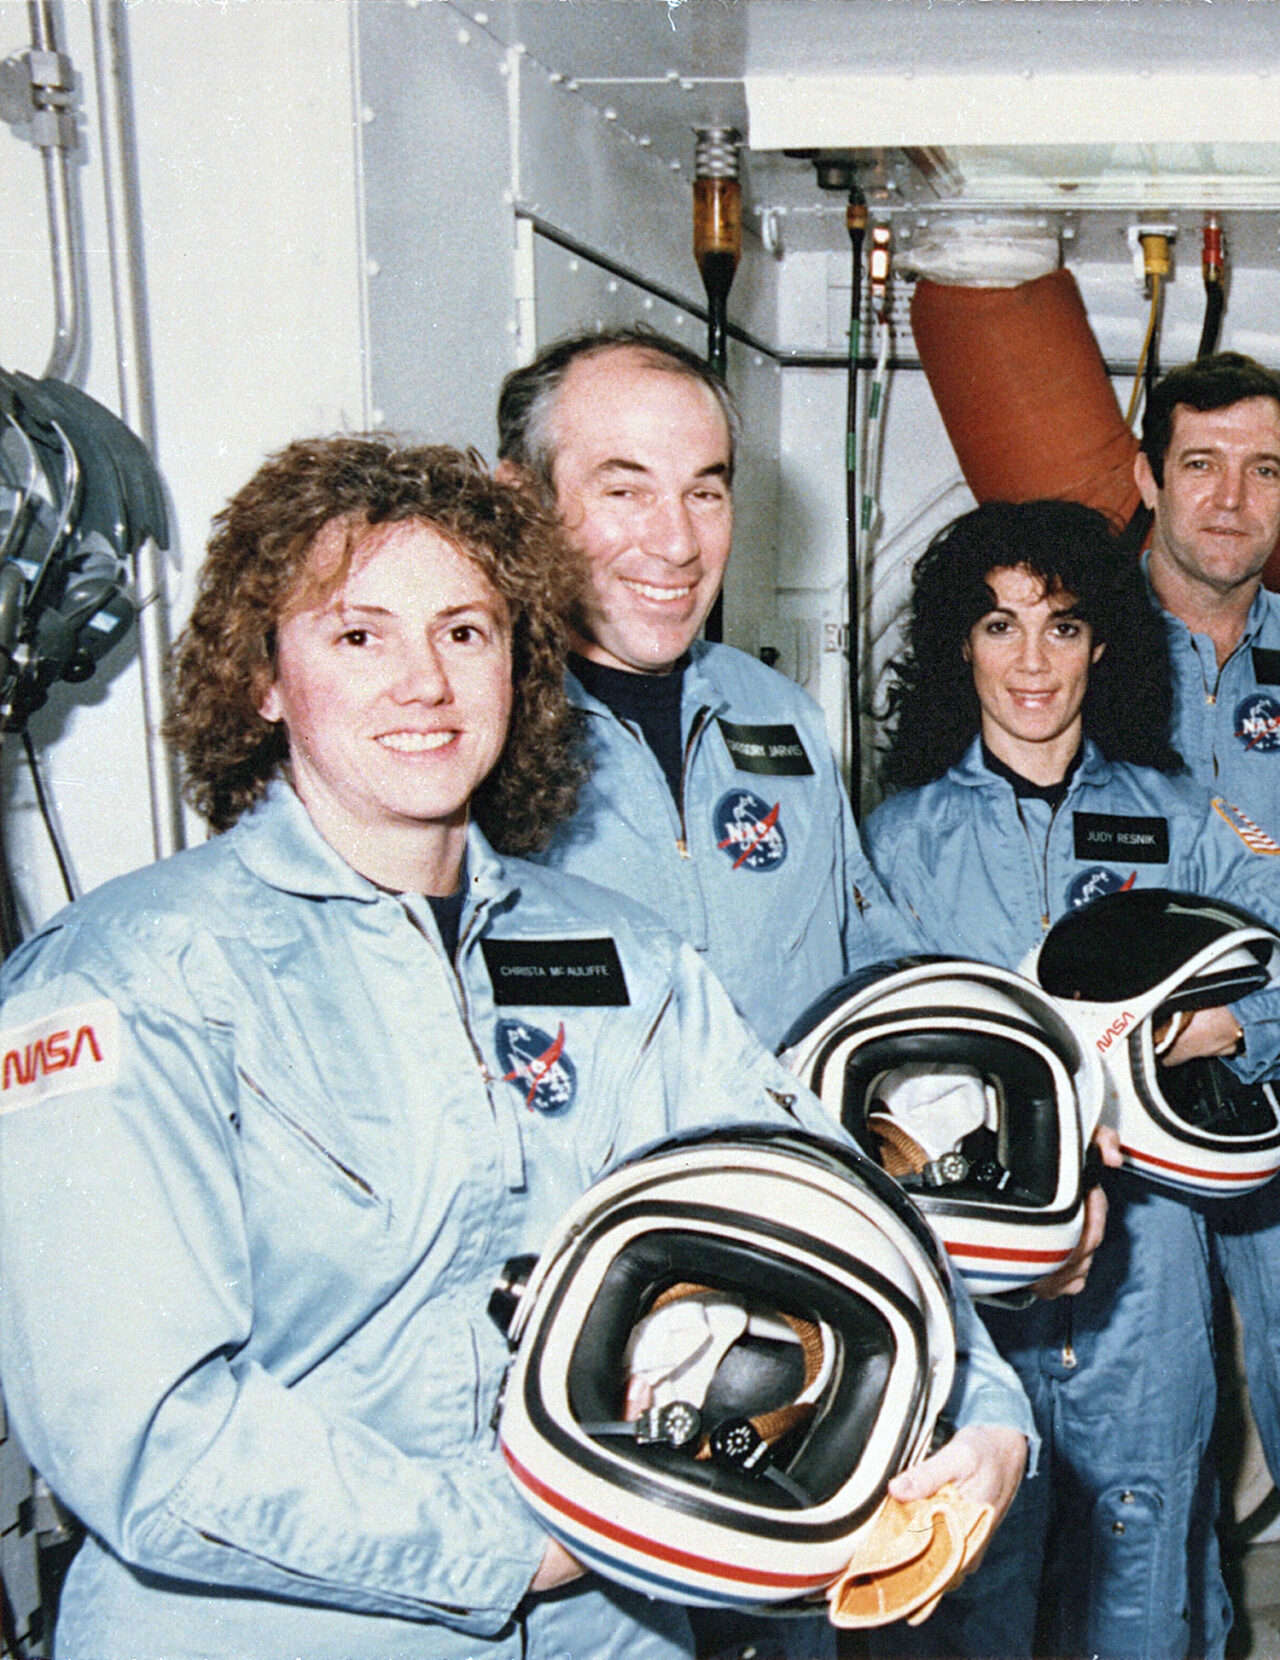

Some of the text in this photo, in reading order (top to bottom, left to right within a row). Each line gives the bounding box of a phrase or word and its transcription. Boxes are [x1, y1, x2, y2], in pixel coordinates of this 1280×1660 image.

[1087, 831, 1157, 846] JUDY RESNIK
[500, 965, 546, 977] CHRISTA
[1096, 1011, 1135, 1053] NASA
[2, 1024, 104, 1091] NASA
